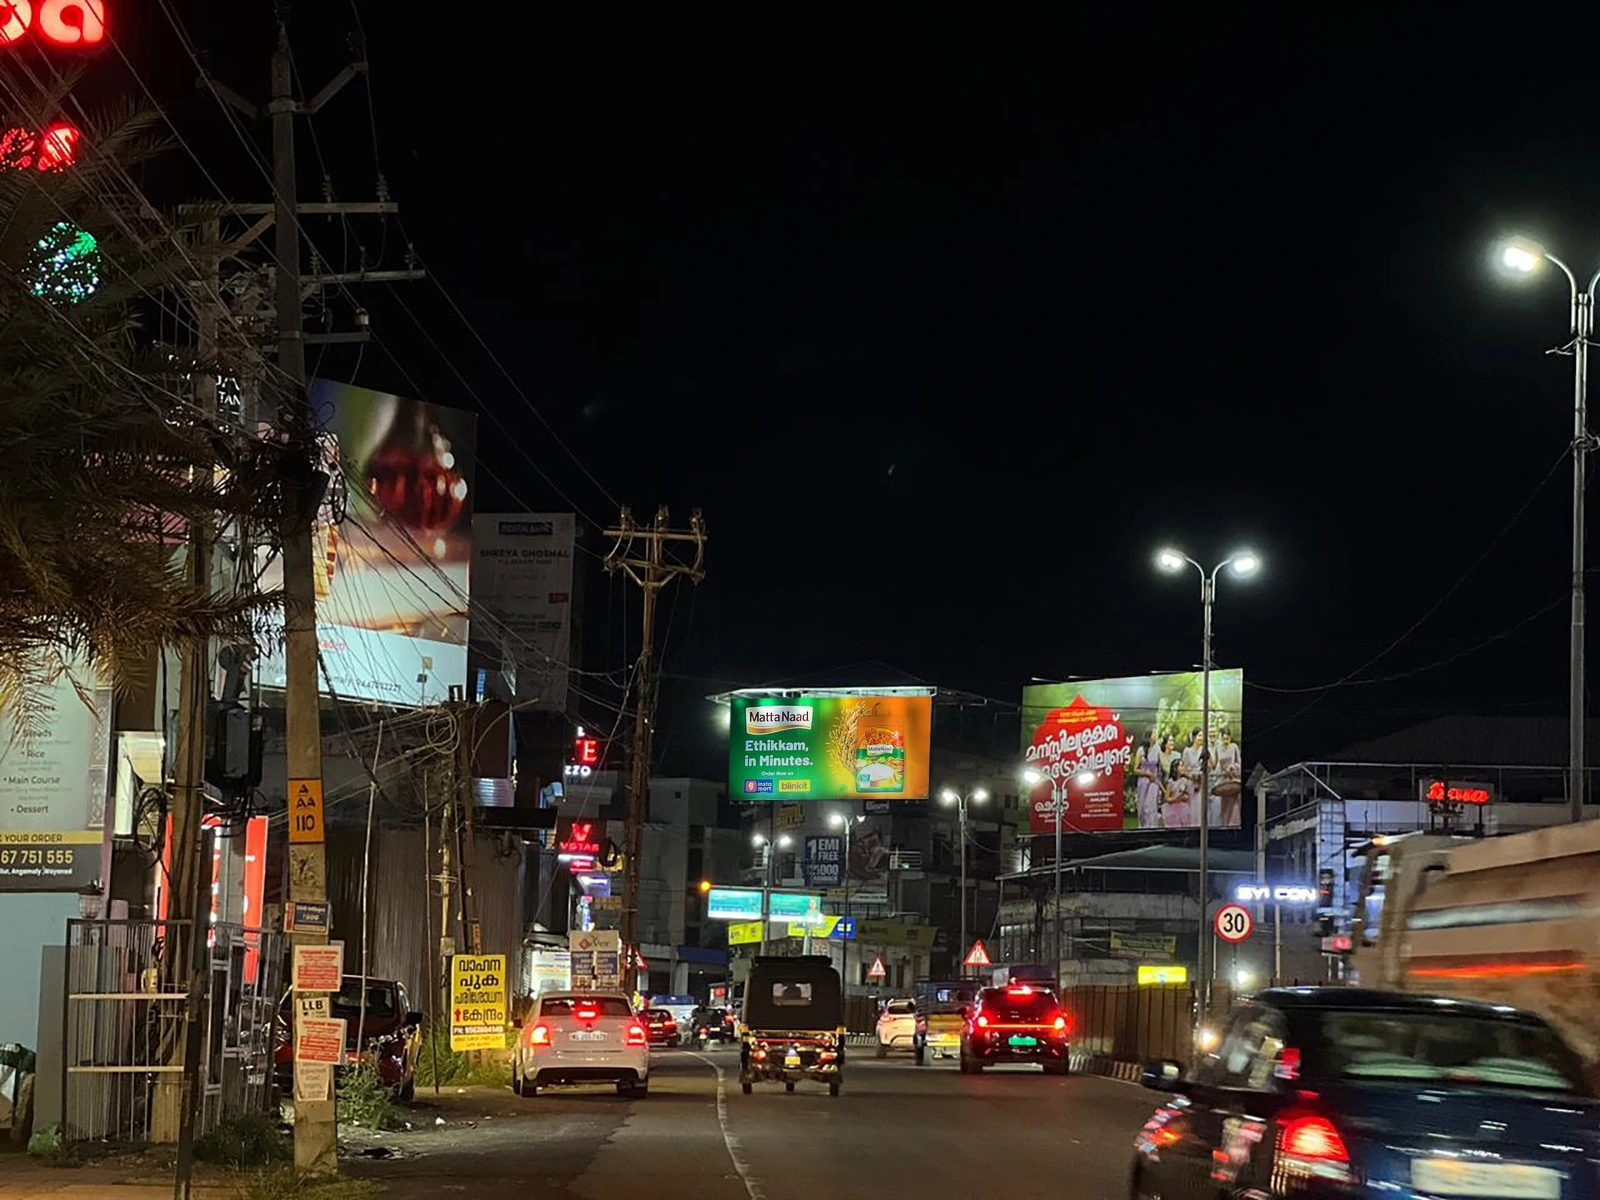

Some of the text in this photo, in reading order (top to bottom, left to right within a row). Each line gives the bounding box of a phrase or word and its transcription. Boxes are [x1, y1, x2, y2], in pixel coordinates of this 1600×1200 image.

[749, 710, 809, 723] Matta Naad
[745, 739, 809, 753] Ethikkam,
[27, 750, 45, 758] Rice
[744, 754, 814, 767] in Minutes.
[9, 776, 61, 785] Main Course
[781, 782, 807, 790] blinkit
[298, 784, 309, 794] A
[16, 804, 49, 813] Dessert
[296, 798, 316, 808] AA
[296, 814, 315, 832] 110
[4, 834, 63, 842] YOUR ORDER
[818, 838, 839, 850] EMI
[21, 850, 42, 864] 751
[47, 850, 74, 864] 555
[818, 851, 839, 861] FREE
[1223, 913, 1245, 932] 30
[459, 959, 501, 972] വാഹന
[459, 974, 499, 990] പുക
[302, 1000, 323, 1010] LLB
